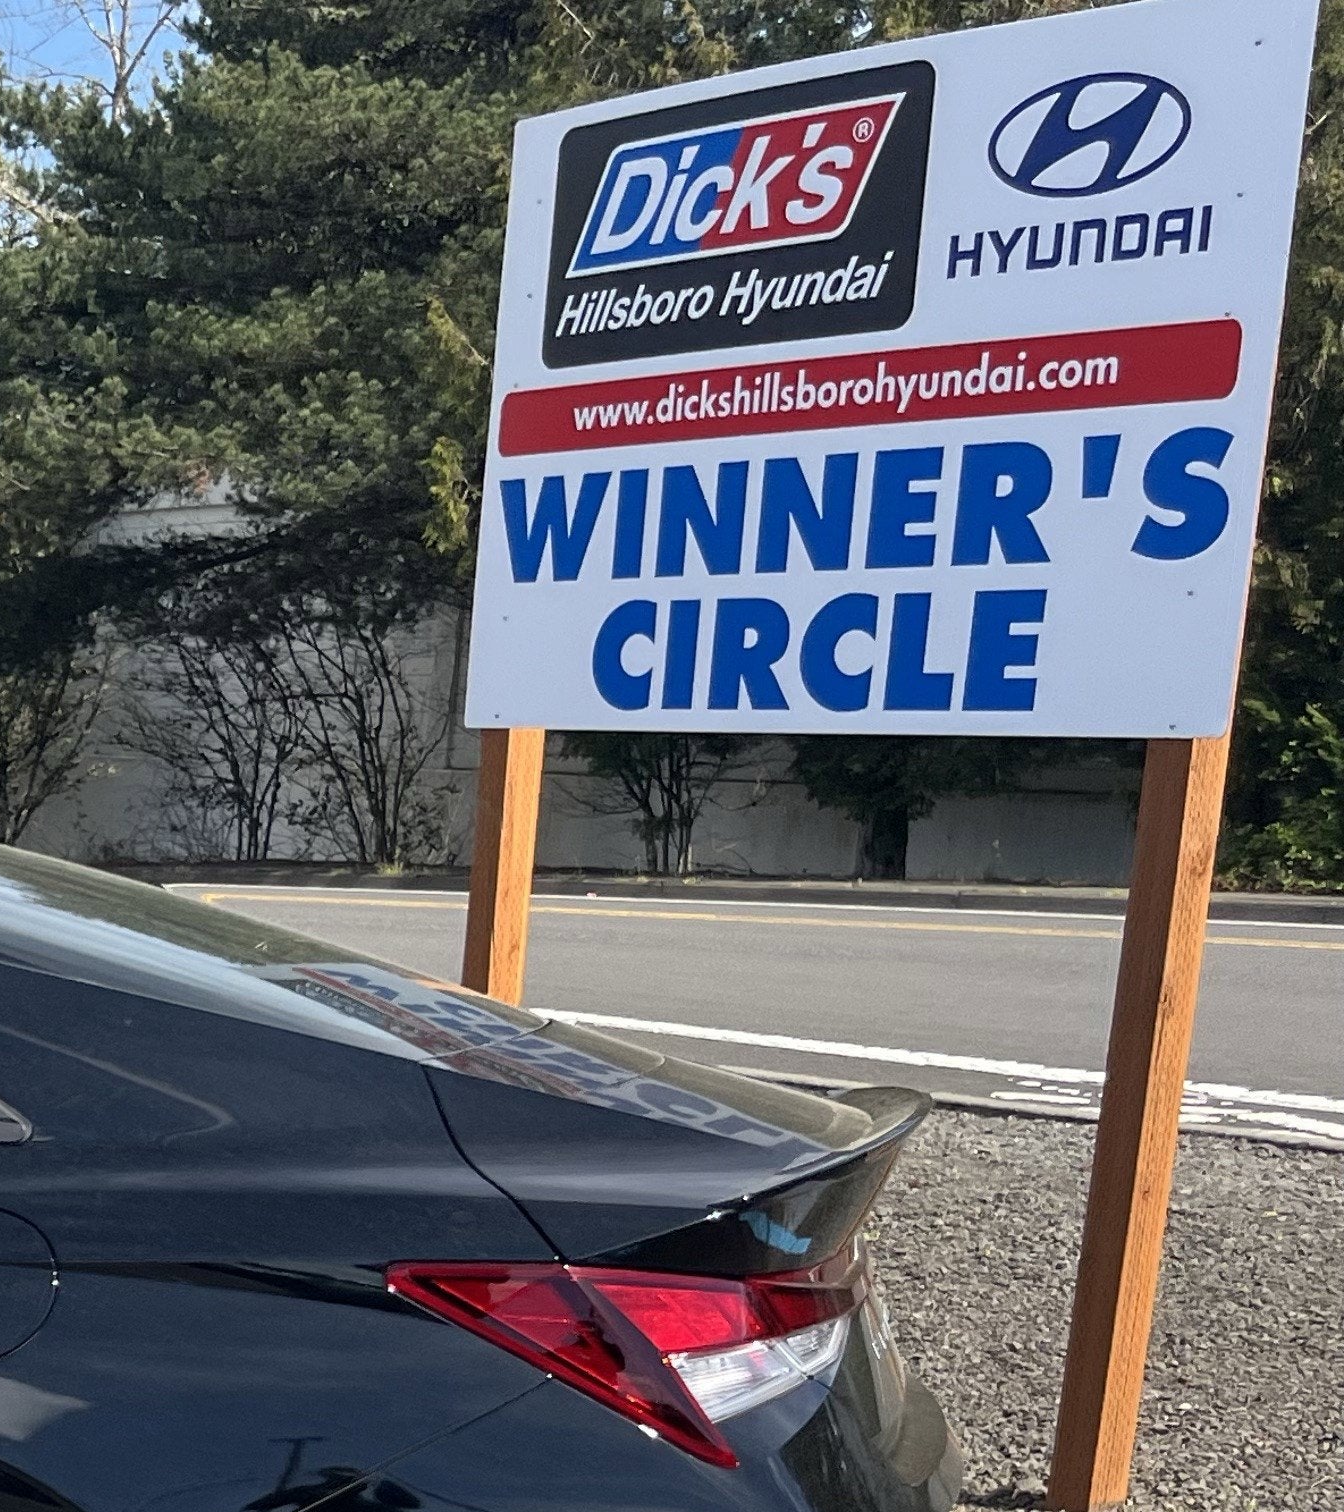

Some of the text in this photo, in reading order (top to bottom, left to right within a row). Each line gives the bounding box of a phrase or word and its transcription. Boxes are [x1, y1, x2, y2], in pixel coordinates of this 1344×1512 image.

[589, 121, 854, 256] Dick's
[555, 250, 895, 338] Hillsboro Hyundai
[946, 204, 1213, 280] HYUNDAI
[572, 352, 1119, 432] www.dickshillsborohyundai.com
[499, 425, 1236, 583] WINNER'S
[592, 588, 1049, 713] CIRCLE
